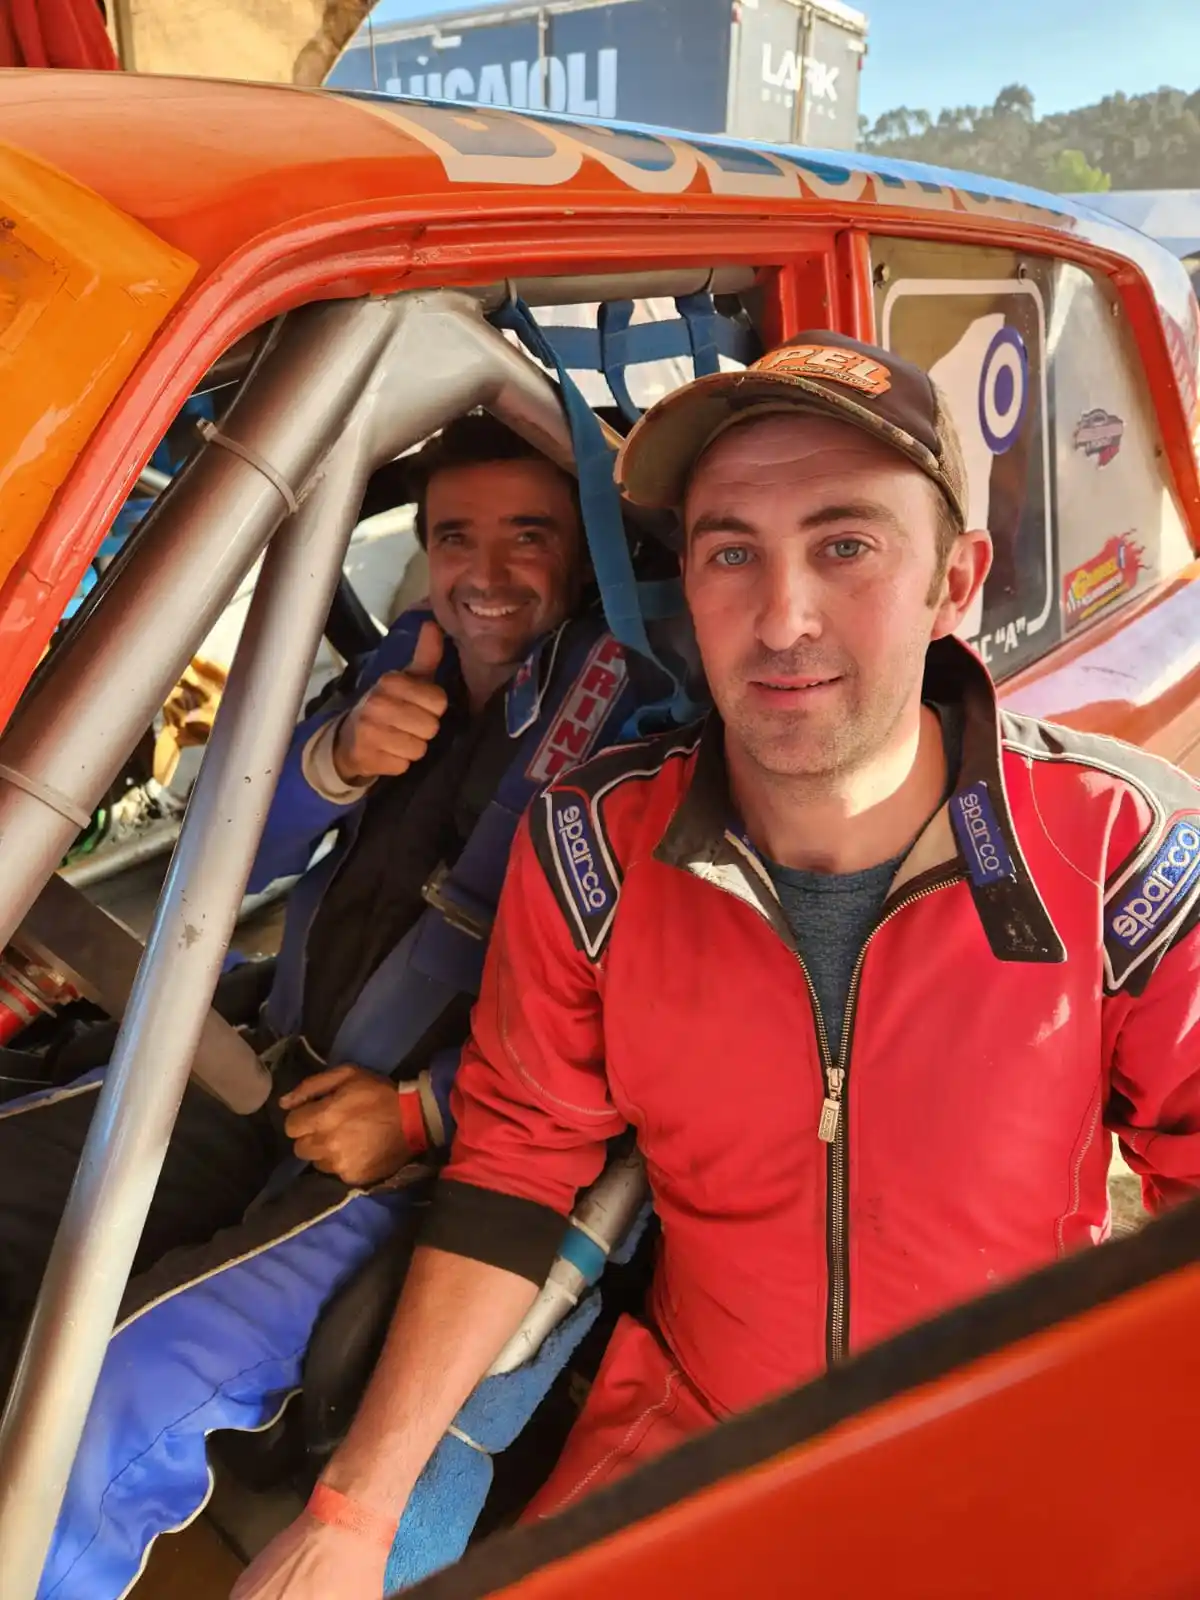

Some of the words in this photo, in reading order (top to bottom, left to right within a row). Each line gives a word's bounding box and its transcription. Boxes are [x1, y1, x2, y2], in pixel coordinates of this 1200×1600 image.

[762, 42, 840, 101] LARK
[753, 347, 880, 386] PEL
[557, 805, 607, 913] sparco
[959, 793, 1000, 875] sparco
[1112, 828, 1200, 947] sparco
